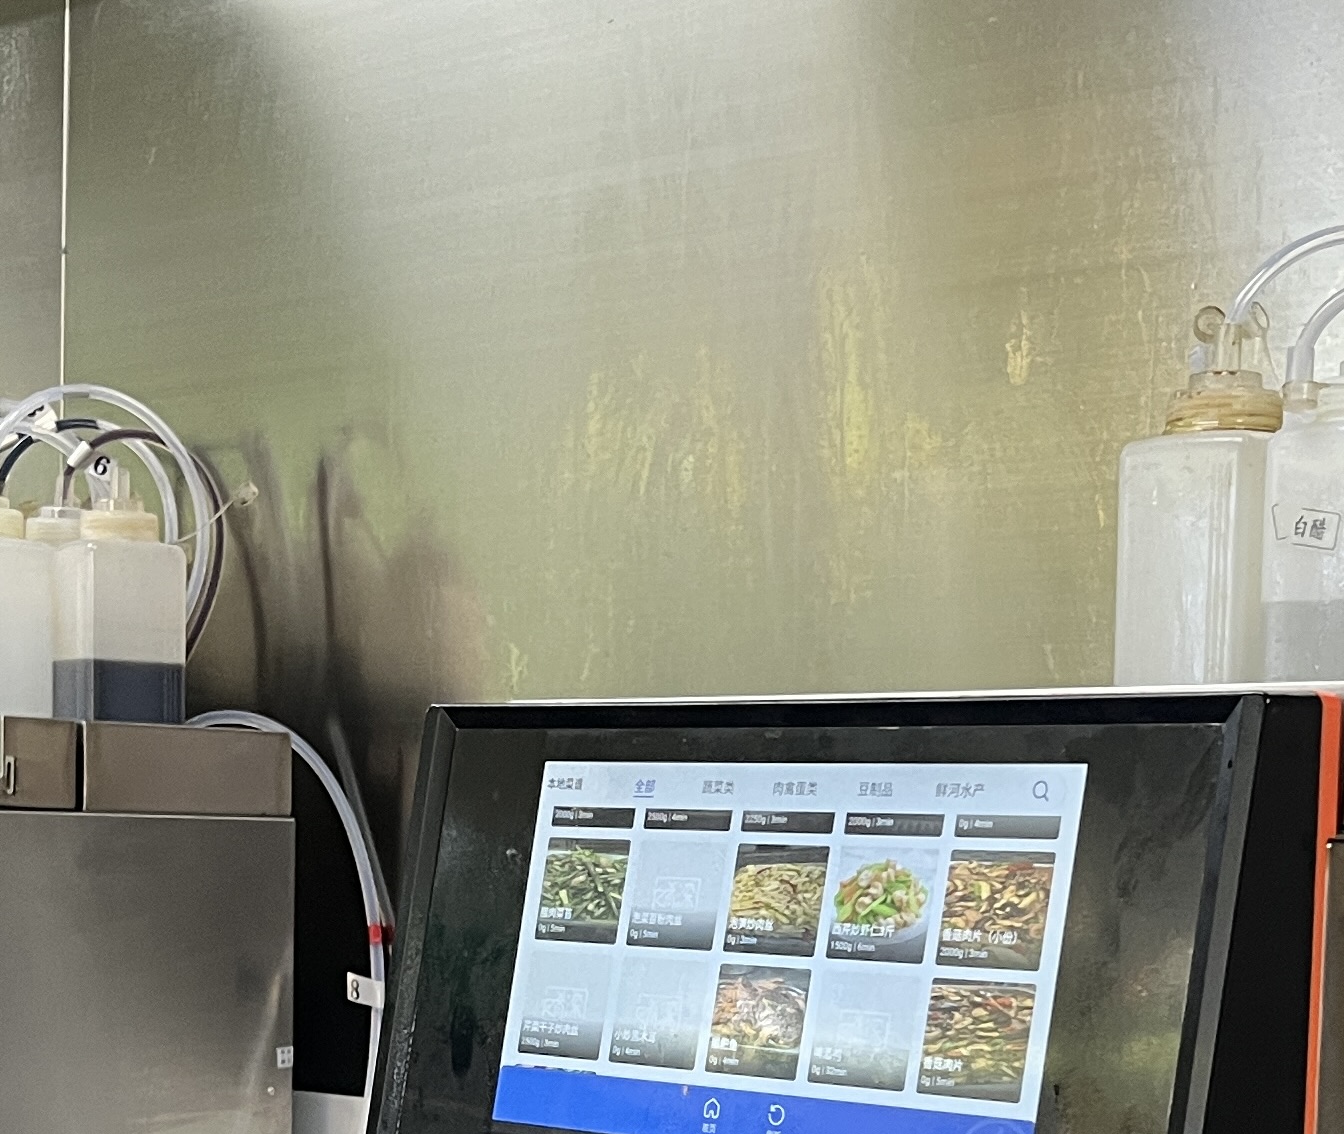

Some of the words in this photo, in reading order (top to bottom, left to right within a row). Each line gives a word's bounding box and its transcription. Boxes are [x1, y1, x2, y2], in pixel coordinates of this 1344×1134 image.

[94, 456, 110, 475] 6
[634, 779, 656, 795] 全部
[702, 780, 735, 795] 蔬菜类
[772, 781, 818, 797] 肉禽蛋类
[858, 782, 893, 797] 豆制品
[935, 782, 985, 798] 鲜河水产
[351, 978, 359, 1000] 8
